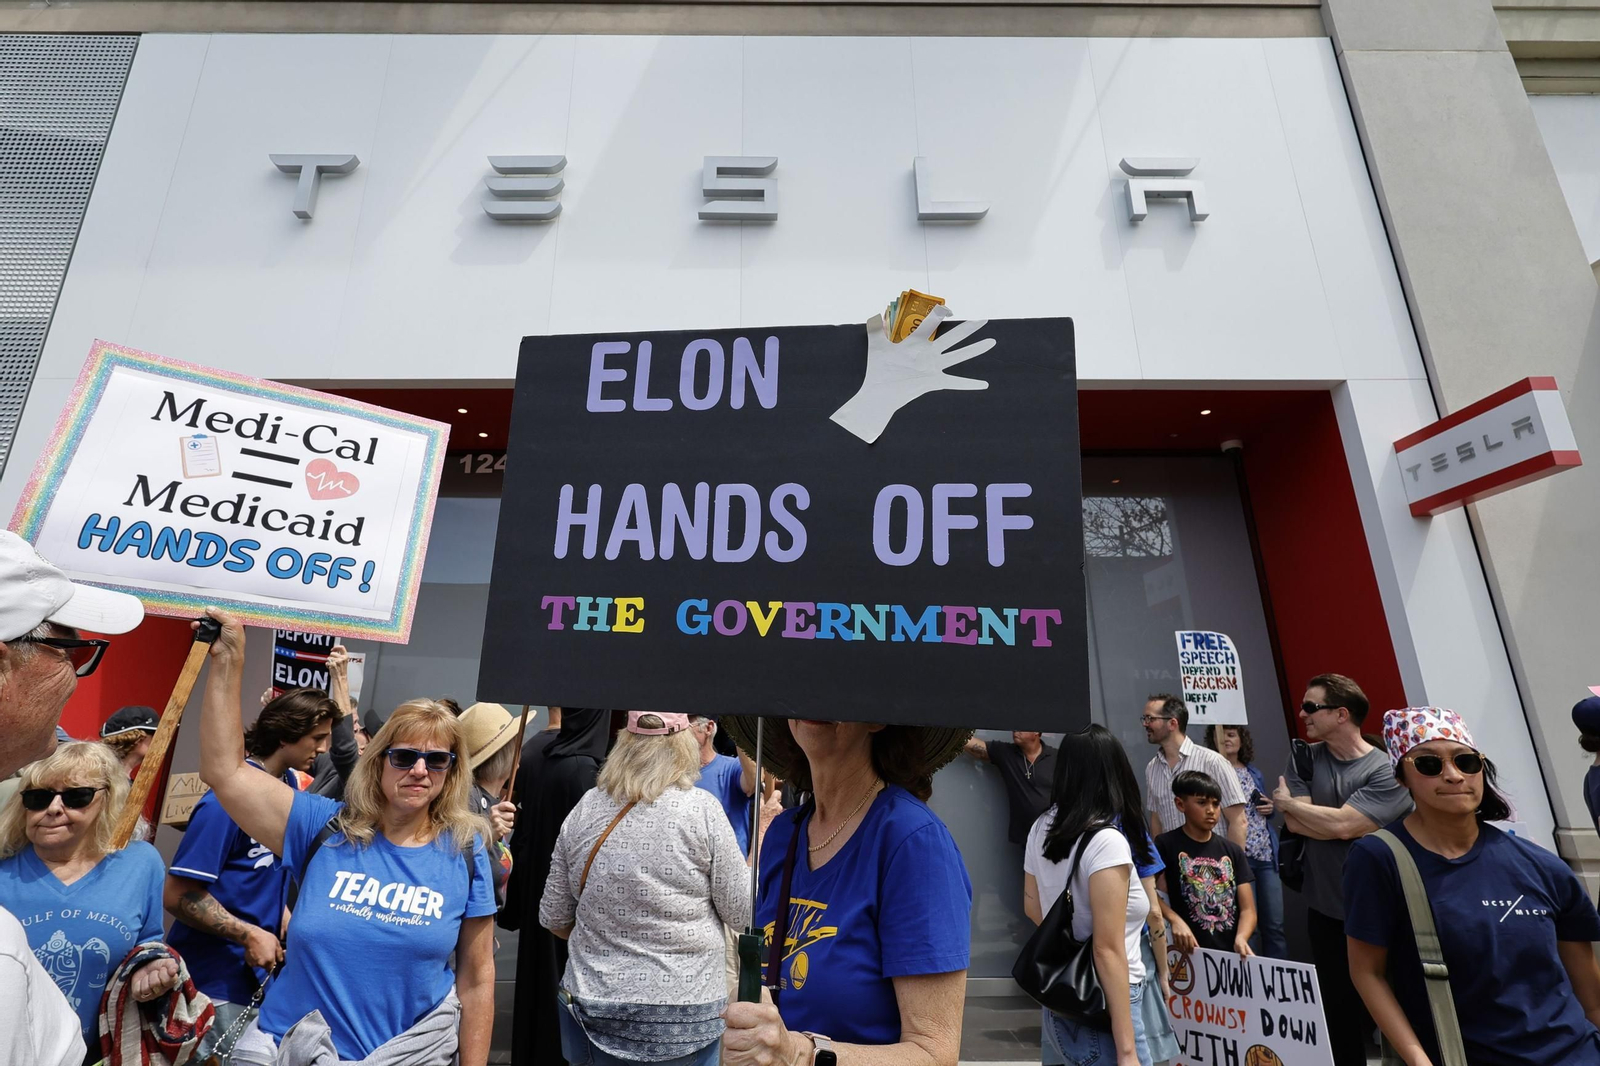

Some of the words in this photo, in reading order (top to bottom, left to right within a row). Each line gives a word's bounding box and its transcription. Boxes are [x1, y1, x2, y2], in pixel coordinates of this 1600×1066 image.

[269, 153, 1209, 222] TESLA
[586, 336, 780, 412] ELON
[151, 391, 378, 465] Medi-Cal
[1405, 415, 1535, 482] TESLA
[122, 475, 364, 546] Medicaid
[553, 481, 811, 563] HANDS
[872, 483, 1034, 567] OFF
[77, 513, 261, 573] HANDS
[266, 546, 376, 593] OFF!
[541, 595, 645, 633] THE
[676, 598, 1062, 647] GOVERNMENT
[1180, 632, 1230, 650] FREE
[275, 662, 329, 690] ELON
[1180, 651, 1236, 665] SPEECH
[1181, 666, 1221, 676] DEFEND
[1225, 666, 1236, 676] IT
[1182, 675, 1238, 690] FASCISM
[1184, 692, 1218, 703] DEFEAT
[1195, 704, 1207, 715] IT
[329, 871, 444, 919] TEACHER
[21, 910, 53, 928] ULF
[61, 908, 81, 919] OF
[87, 910, 132, 942] MEXICO
[1203, 952, 1253, 999] DOWN
[1259, 964, 1316, 1005] WITH
[1168, 995, 1246, 1034] CROWNS!
[1260, 1008, 1317, 1046] DOWN
